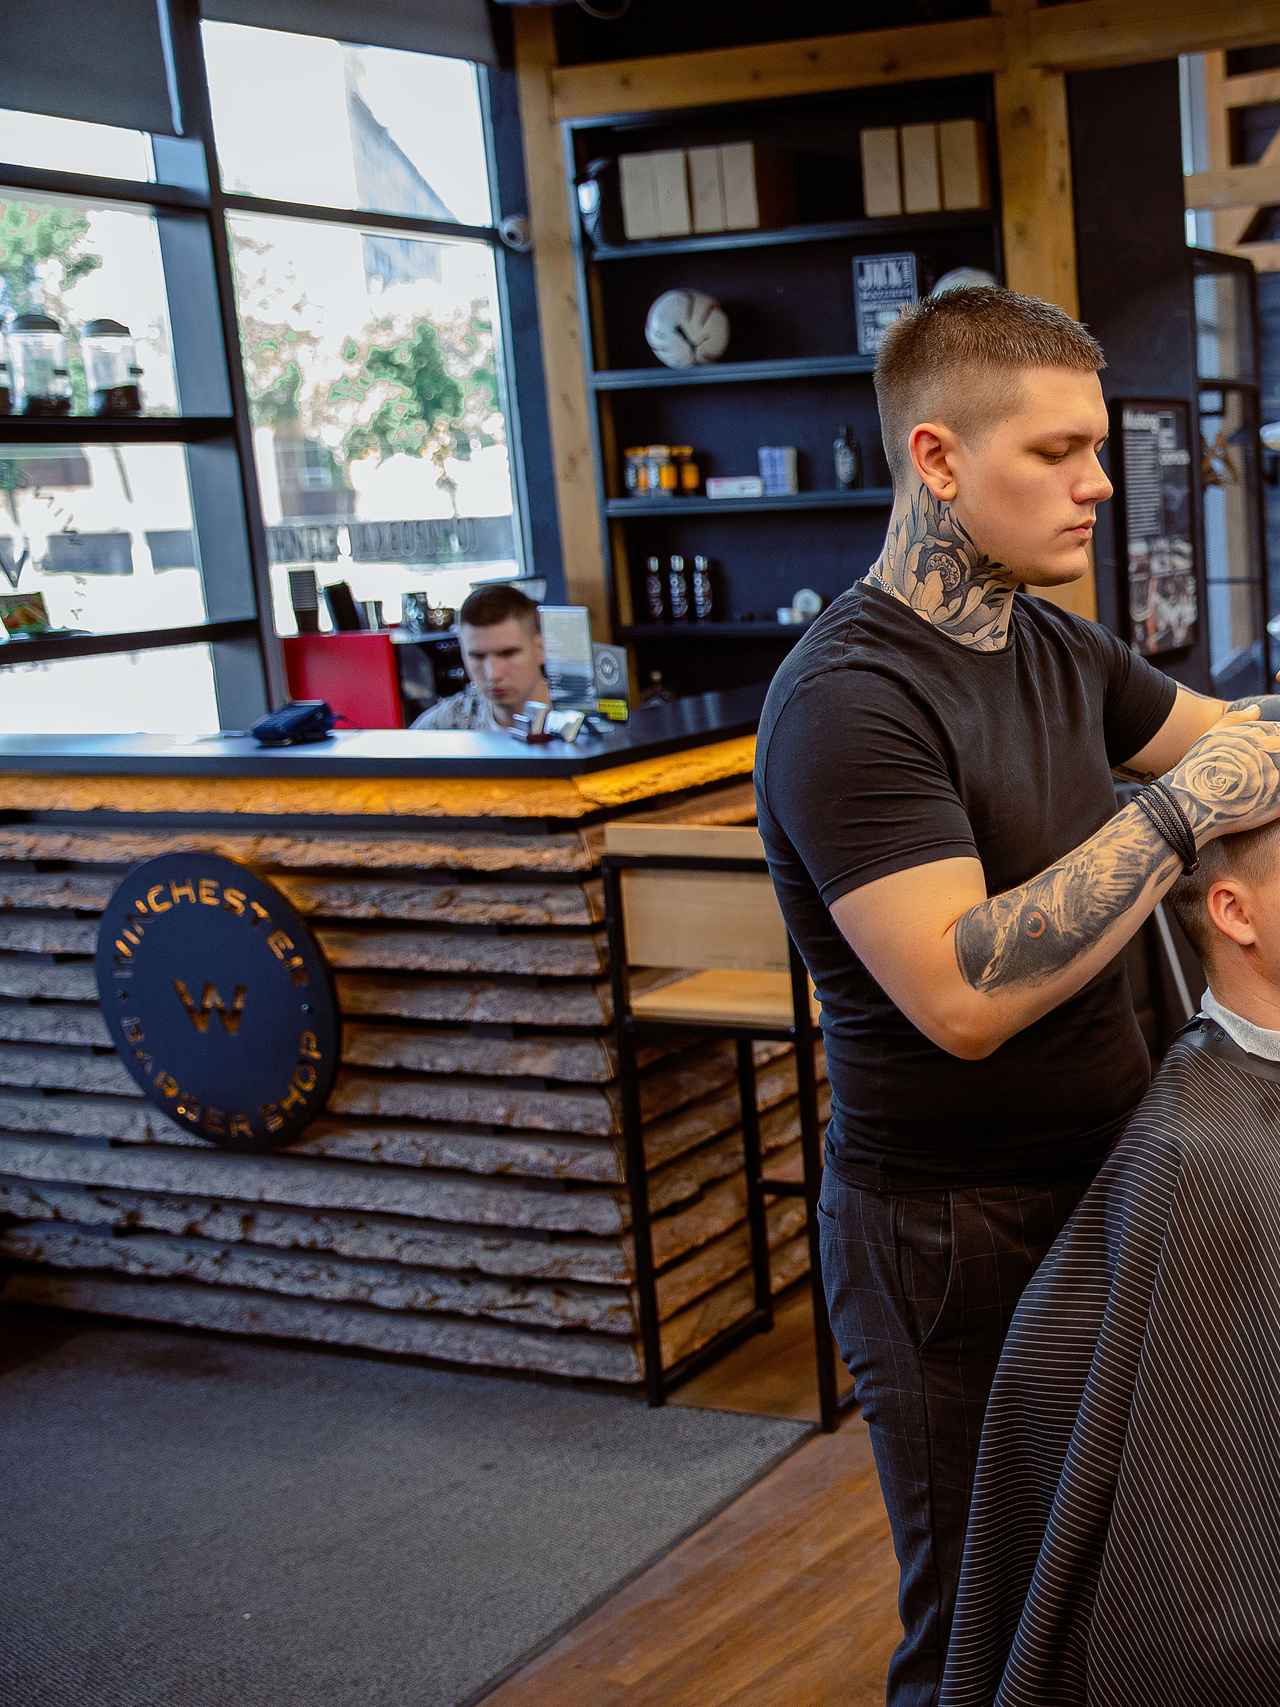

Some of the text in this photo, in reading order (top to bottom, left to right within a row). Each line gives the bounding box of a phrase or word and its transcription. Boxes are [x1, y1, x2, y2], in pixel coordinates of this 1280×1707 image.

[112, 877, 309, 988] WINCHESTER
[173, 978, 247, 1036] W
[258, 1029, 322, 1133] SHOP
